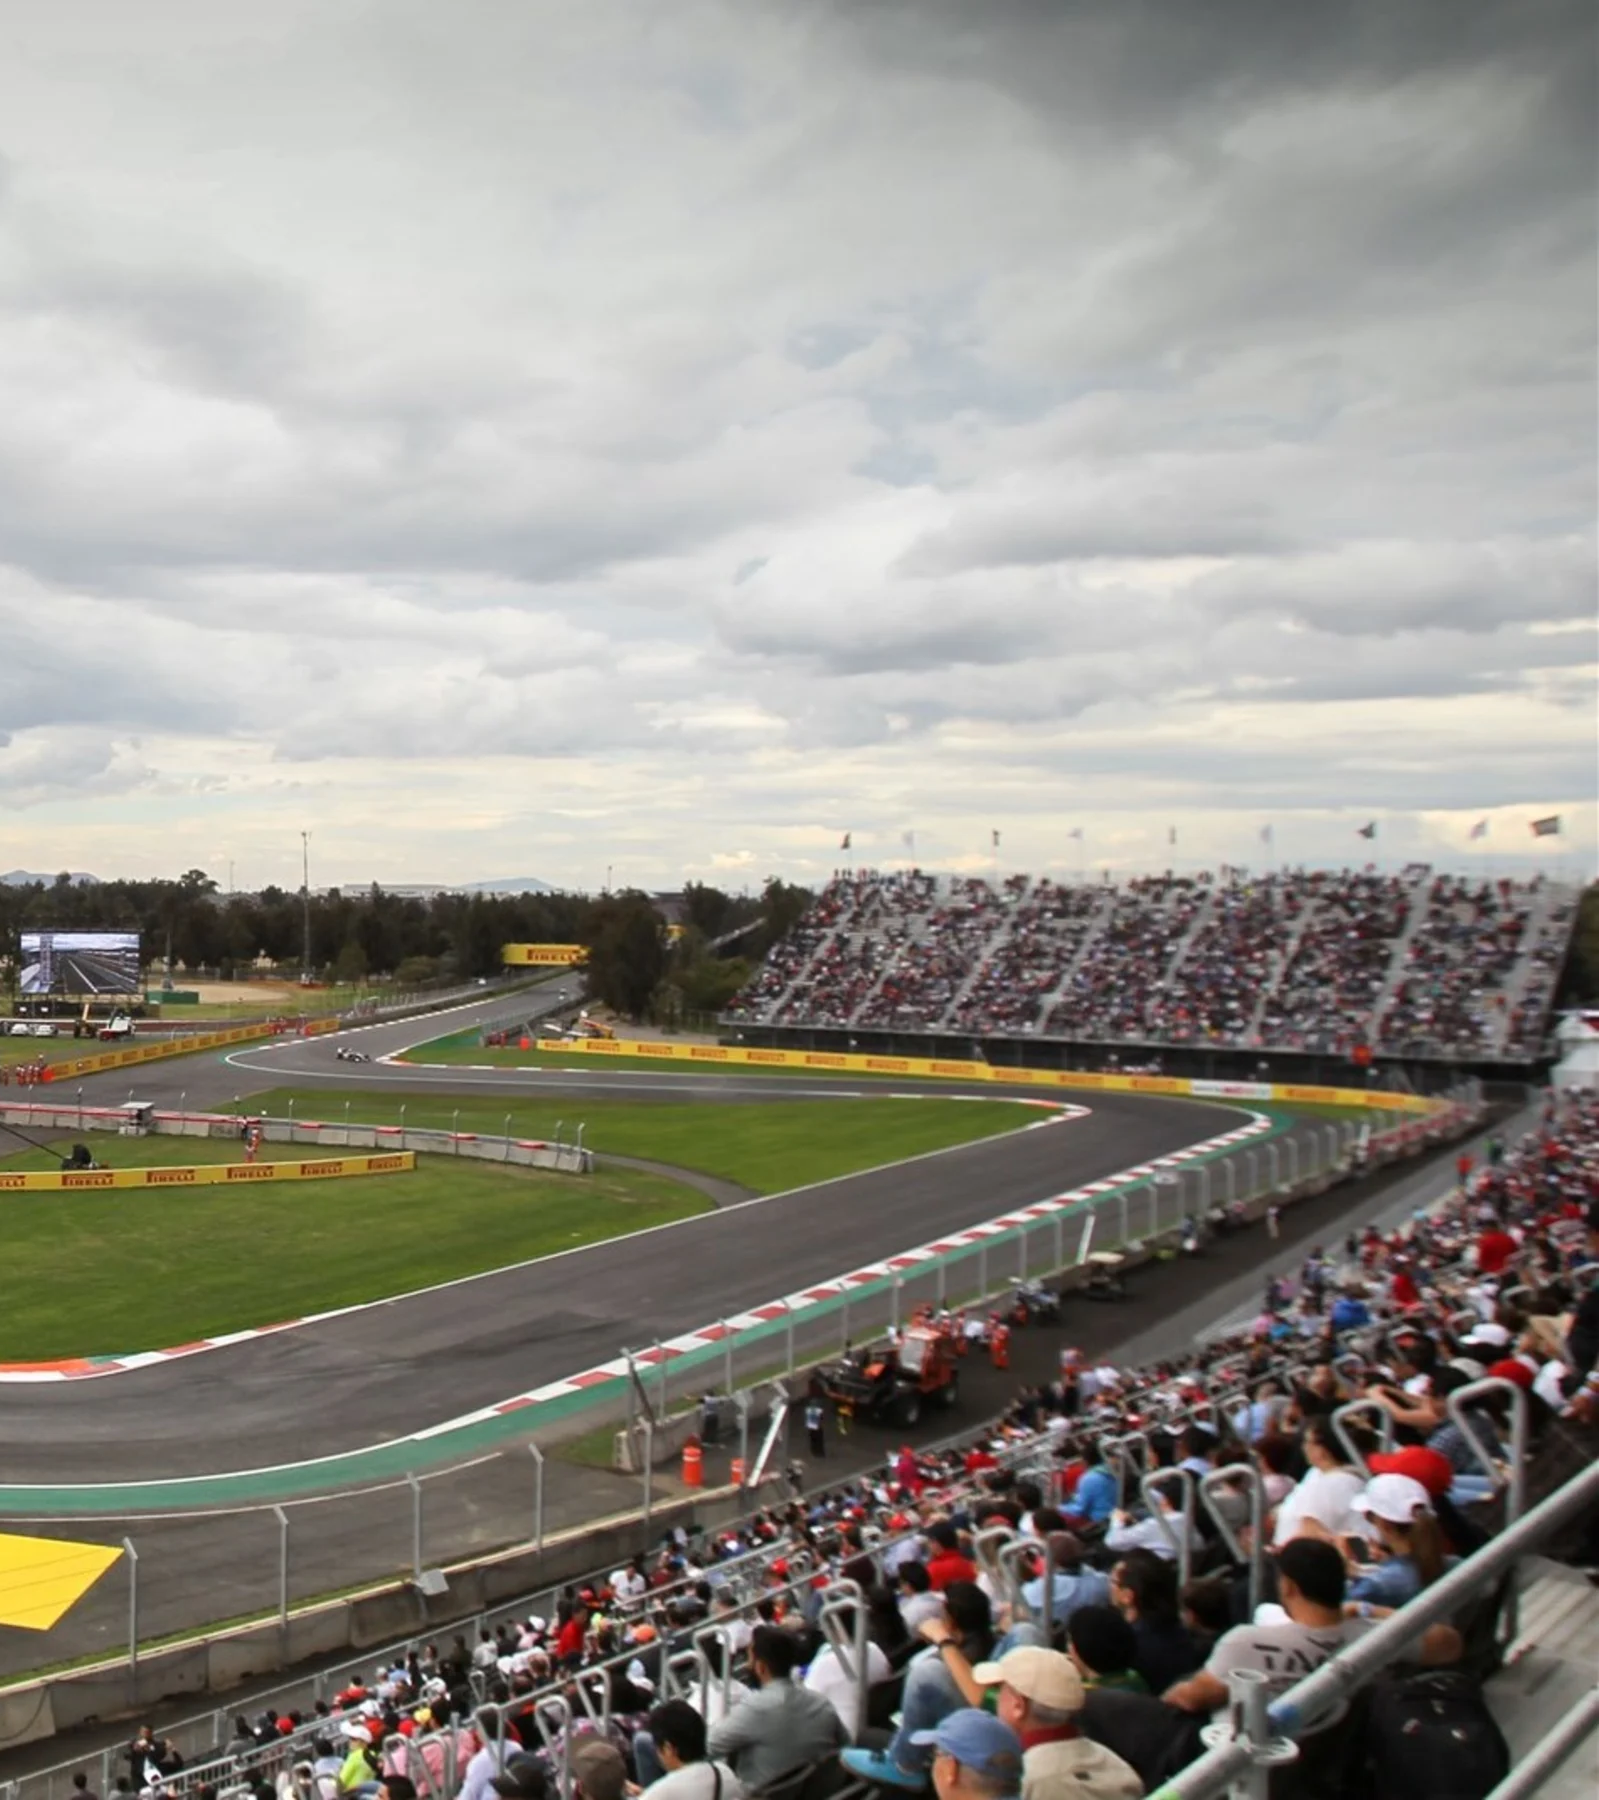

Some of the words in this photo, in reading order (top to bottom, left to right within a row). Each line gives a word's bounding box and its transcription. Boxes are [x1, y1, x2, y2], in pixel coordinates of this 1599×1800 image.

[226, 1165, 274, 1179] PIRELLI
[300, 1161, 343, 1176] PIRELLI
[61, 1173, 113, 1186] PIRELLI
[146, 1169, 195, 1183] PIRELLI
